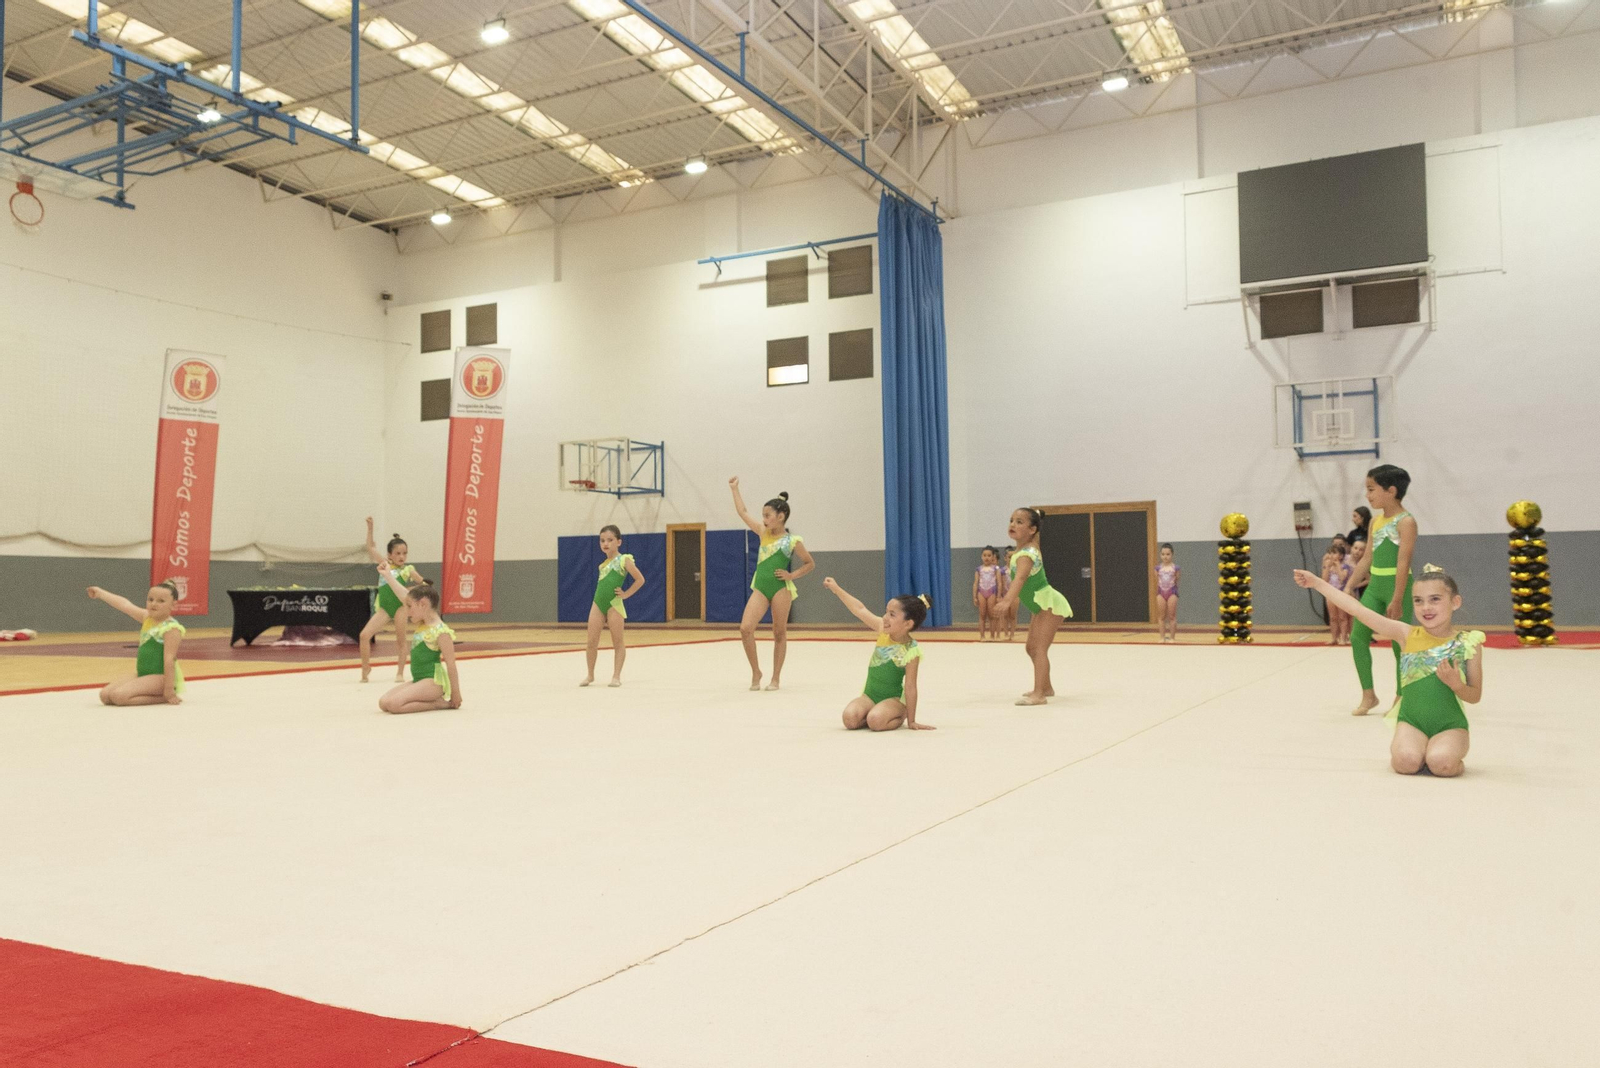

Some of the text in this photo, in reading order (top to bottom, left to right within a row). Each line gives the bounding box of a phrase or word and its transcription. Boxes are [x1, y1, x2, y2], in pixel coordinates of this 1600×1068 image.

[176, 428, 198, 502] Deporte
[465, 424, 484, 499] Deporte
[169, 510, 190, 568] Somos
[459, 507, 477, 566] Somos
